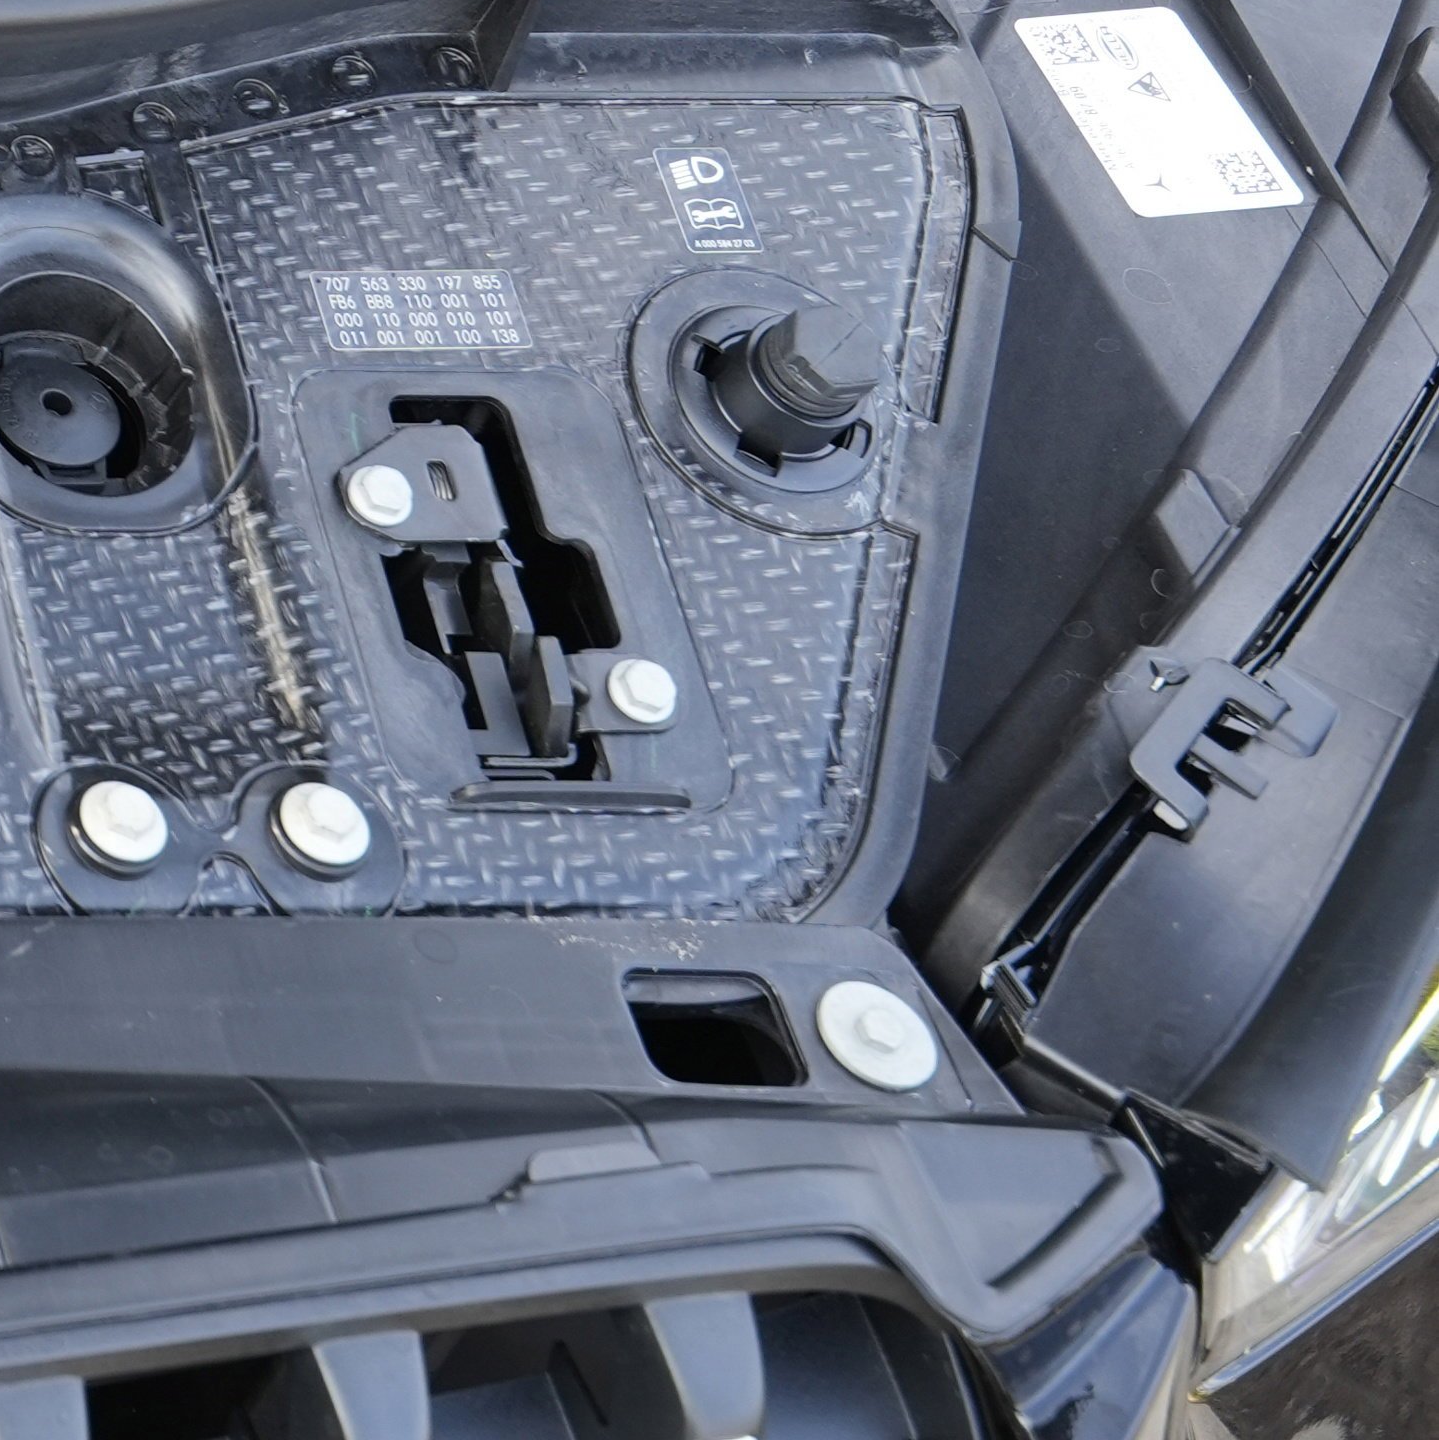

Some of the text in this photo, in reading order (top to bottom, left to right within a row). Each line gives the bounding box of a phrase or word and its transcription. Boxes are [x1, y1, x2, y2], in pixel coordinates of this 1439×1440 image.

[1099, 25, 1133, 67] HELLA
[323, 275, 502, 292] 707 563 330 197 855
[328, 293, 507, 310] FB6 BB8 110 001 101
[334, 311, 513, 328] 000 110 000 010 101
[340, 329, 519, 345] 011 001 001 100 138
